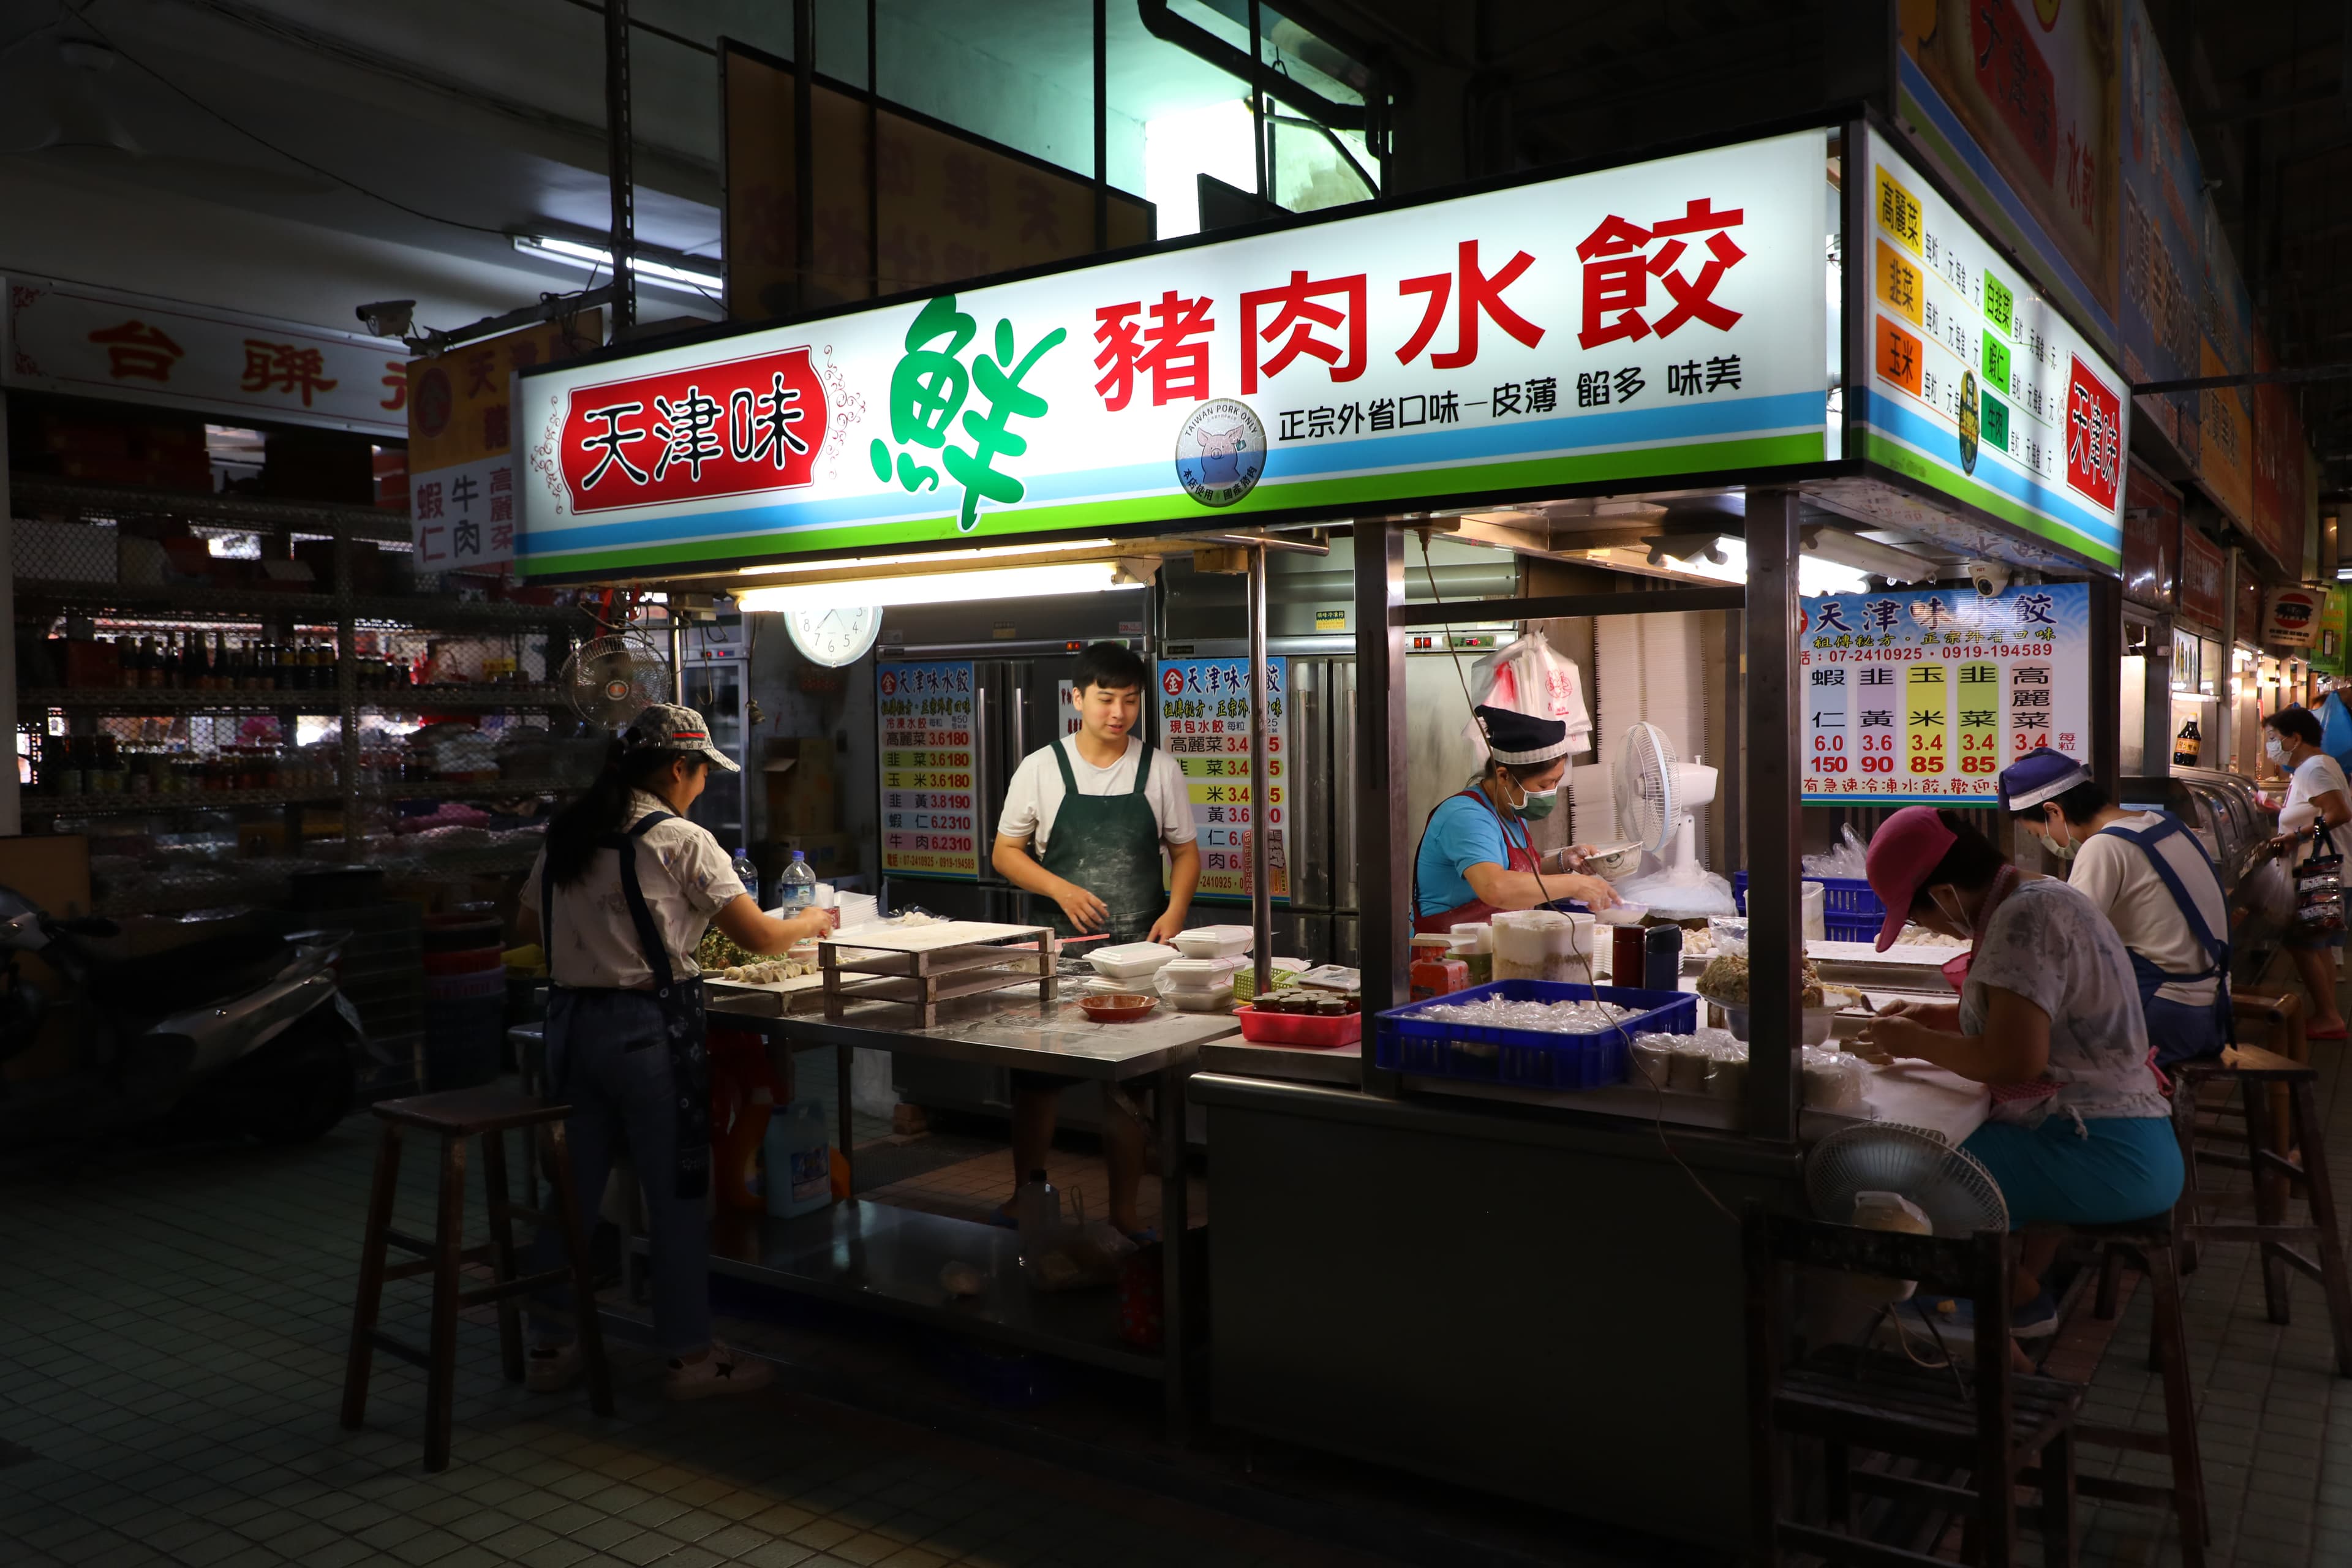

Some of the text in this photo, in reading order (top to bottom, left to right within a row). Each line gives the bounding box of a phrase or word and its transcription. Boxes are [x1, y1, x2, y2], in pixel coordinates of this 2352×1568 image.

[1882, 181, 1918, 247] 高麗菜
[1890, 258, 1914, 312] 韭菜
[870, 293, 1066, 532] 鮮
[1094, 197, 1746, 412] 豬肉水餃
[1889, 331, 1913, 383] 玉米
[1989, 342, 2004, 384] 蝦仁
[1577, 366, 1646, 409] 餡多
[1668, 353, 1741, 397] 味美
[1185, 404, 1257, 436] TAIWAN PORK ONLY
[1988, 401, 2003, 444] 牛肉
[581, 371, 809, 490] 天津味
[2071, 381, 2117, 494] 天津味
[1183, 466, 1257, 501] 本店使用 國產豬肉
[451, 475, 480, 557] 牛肉
[489, 467, 513, 551] 高麗菜
[417, 481, 446, 562] 蝦仁
[1814, 594, 2057, 633] 天津味水餃
[804, 619, 810, 631] 8
[853, 622, 859, 634] 4
[815, 633, 820, 646] 7
[828, 639, 834, 652] 6
[843, 635, 850, 647] 5
[1813, 633, 1896, 649] 祖傳秘方
[1830, 646, 1922, 662] 07-2410925
[1942, 643, 2052, 659] 0919-194589
[882, 669, 970, 695] 金 天津味水餃
[1166, 672, 1182, 693] 金
[1811, 669, 1845, 728] 蝦仁
[1860, 668, 1894, 728] 韭黃
[1909, 666, 1945, 727] 玉米
[1959, 666, 1997, 728] 韭菜
[2012, 667, 2051, 729] 高麗菜
[1216, 698, 1283, 718] 正宗外味
[1170, 720, 1224, 734] 現包水餃
[1227, 721, 1245, 731] 每粒
[886, 733, 968, 746] 高麗菜 3.6 180
[1170, 736, 1223, 753] 高麗菜
[1227, 737, 1248, 752] 3.4
[1814, 733, 2048, 752] 6.0 3.6 3.4 3.4 3.4
[2059, 733, 2076, 751] 每粒
[930, 753, 945, 766] 3.6
[948, 753, 969, 766] 180
[1227, 761, 1249, 775] 3.4
[1268, 760, 1280, 775] 5
[1811, 756, 1996, 773] 150 90 85 85
[930, 774, 945, 787] 3.6
[948, 774, 970, 788] 180
[1803, 777, 1999, 795] 有急速冷凍水餃,歡迎
[931, 795, 946, 808] 3.8
[949, 796, 970, 809] 190
[1207, 786, 1280, 802] 米 3.4 5
[931, 816, 946, 829] 6.2
[949, 816, 971, 829] 310
[1229, 808, 1250, 823] 3.6
[1268, 808, 1281, 823] 0
[932, 836, 948, 850] 6.2
[949, 837, 971, 851] 310
[1208, 829, 1244, 846] 仁 6.
[1208, 853, 1224, 869] 肉
